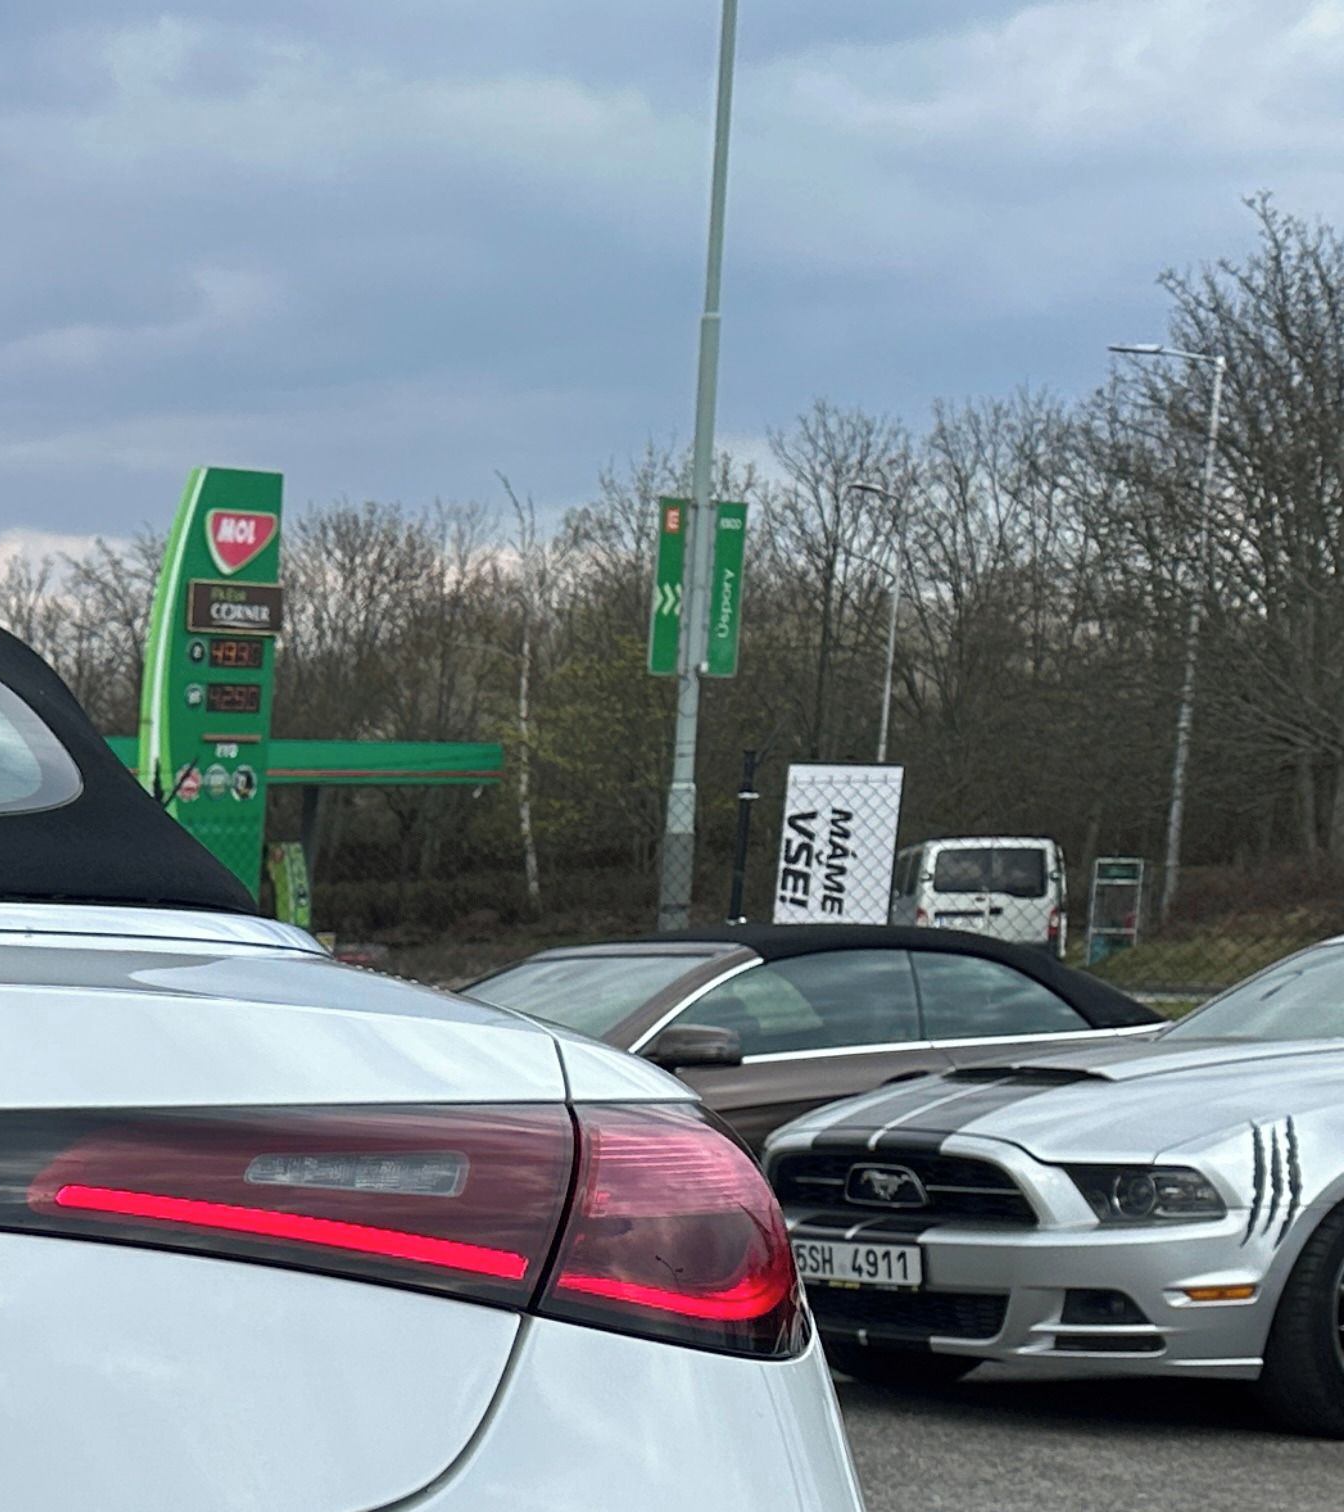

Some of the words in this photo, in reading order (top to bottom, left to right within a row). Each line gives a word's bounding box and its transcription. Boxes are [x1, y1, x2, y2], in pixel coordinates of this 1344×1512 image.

[216, 518, 256, 545] MOL
[210, 603, 270, 622] CORNER
[779, 810, 824, 909] VŠE!
[820, 806, 858, 915] MÁME
[794, 1244, 834, 1275] 5SH
[852, 1248, 908, 1280] 4911
